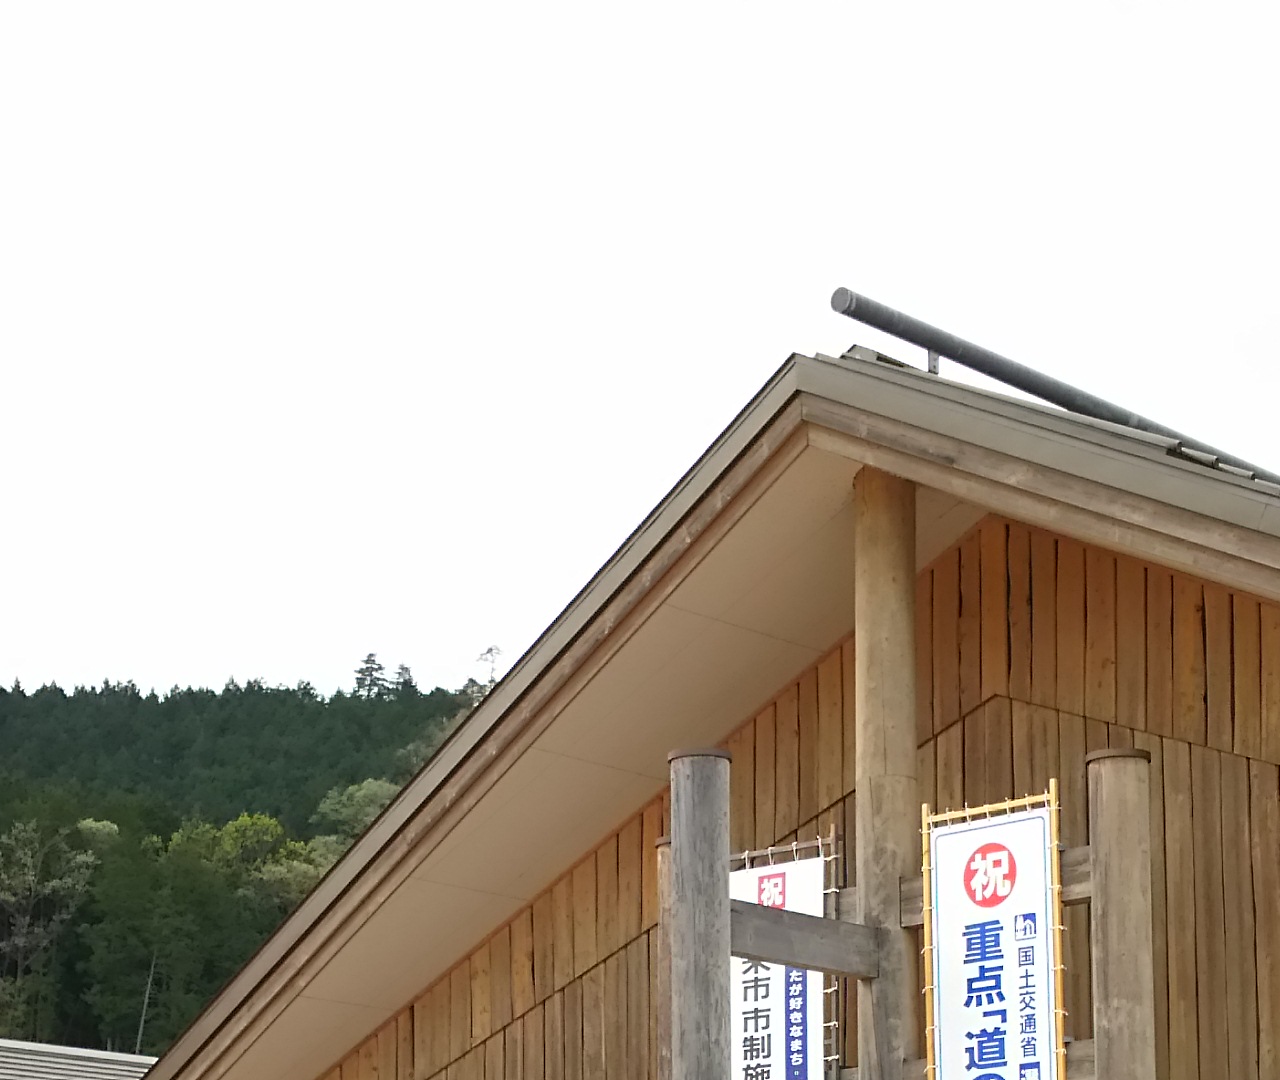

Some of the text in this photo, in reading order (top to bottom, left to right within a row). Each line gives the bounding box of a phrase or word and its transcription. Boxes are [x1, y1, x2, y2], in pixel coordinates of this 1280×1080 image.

[760, 877, 784, 907] 祝
[970, 850, 1011, 902] 祝
[1018, 945, 1037, 1058] 国土交通省
